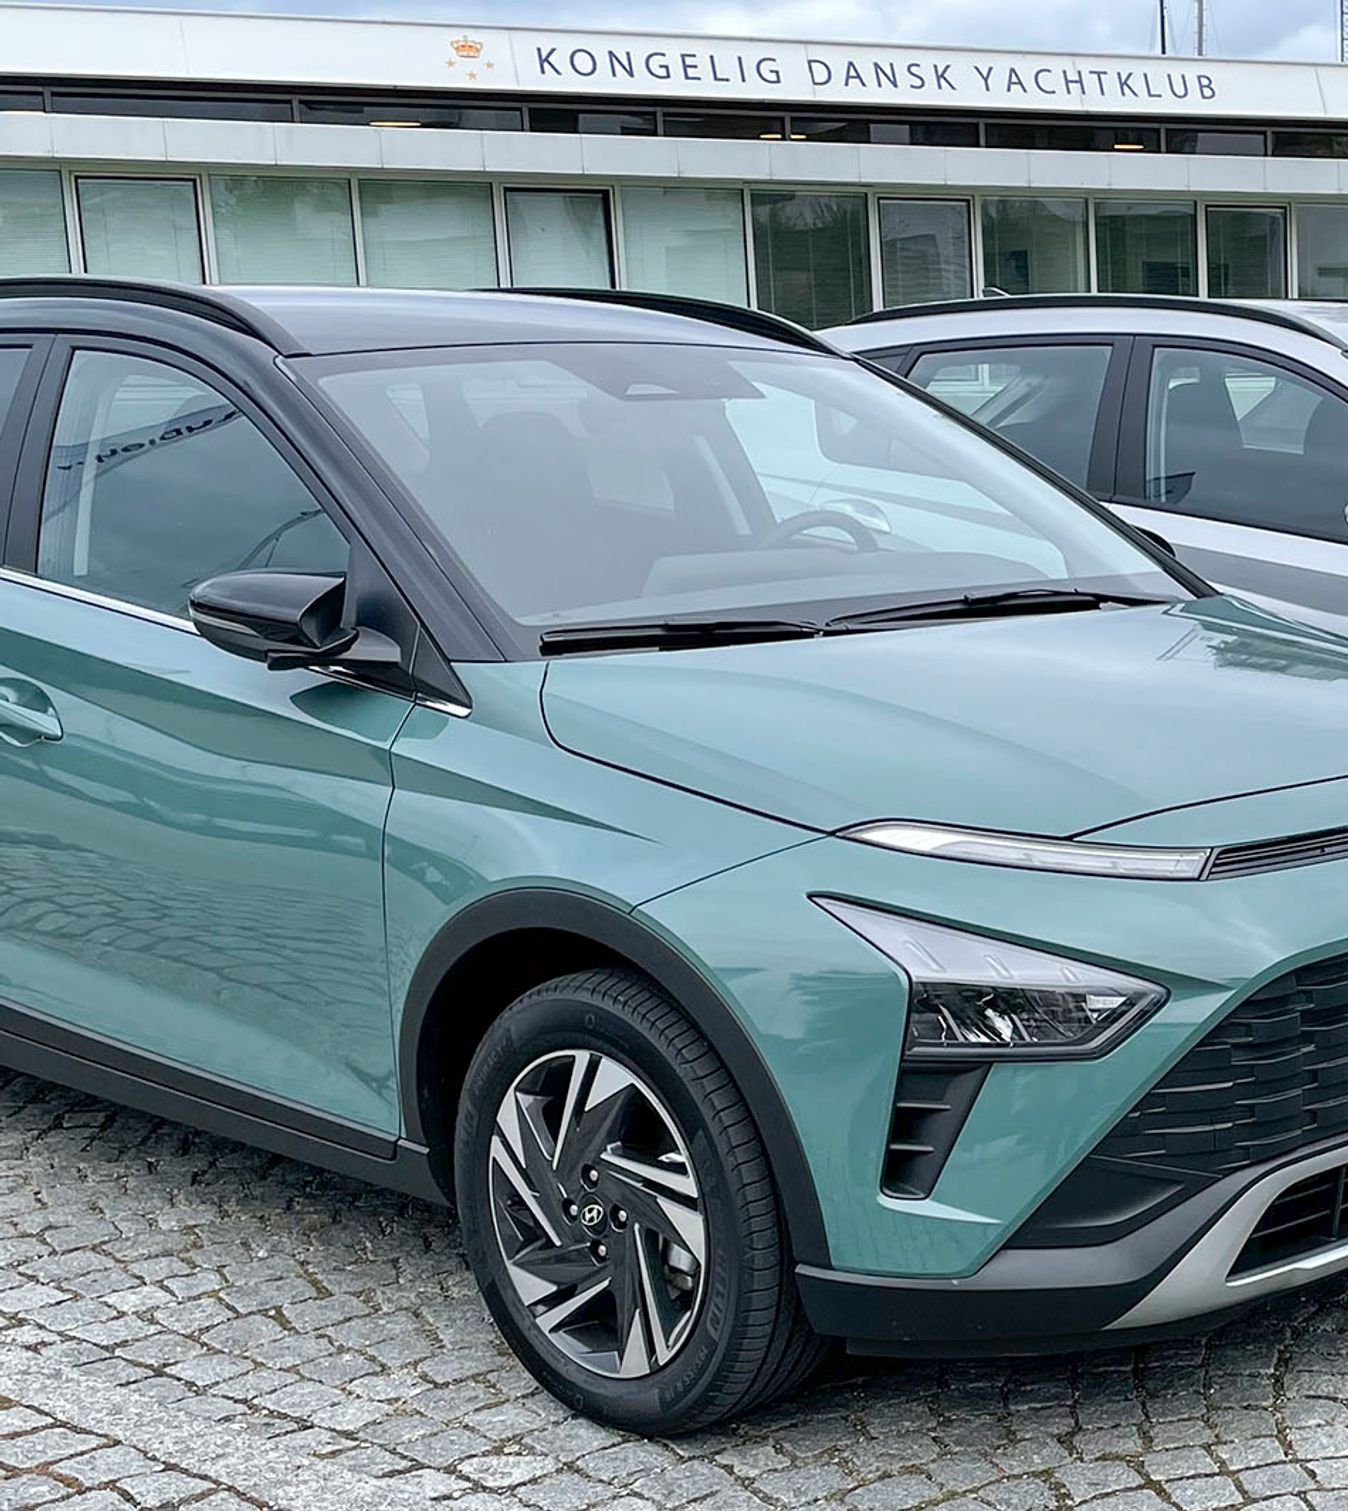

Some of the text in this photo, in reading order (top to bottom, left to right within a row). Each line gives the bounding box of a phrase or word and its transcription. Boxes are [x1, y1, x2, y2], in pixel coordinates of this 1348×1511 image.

[536, 46, 1217, 100] KONGELIG DANSK YACHTKLUB
